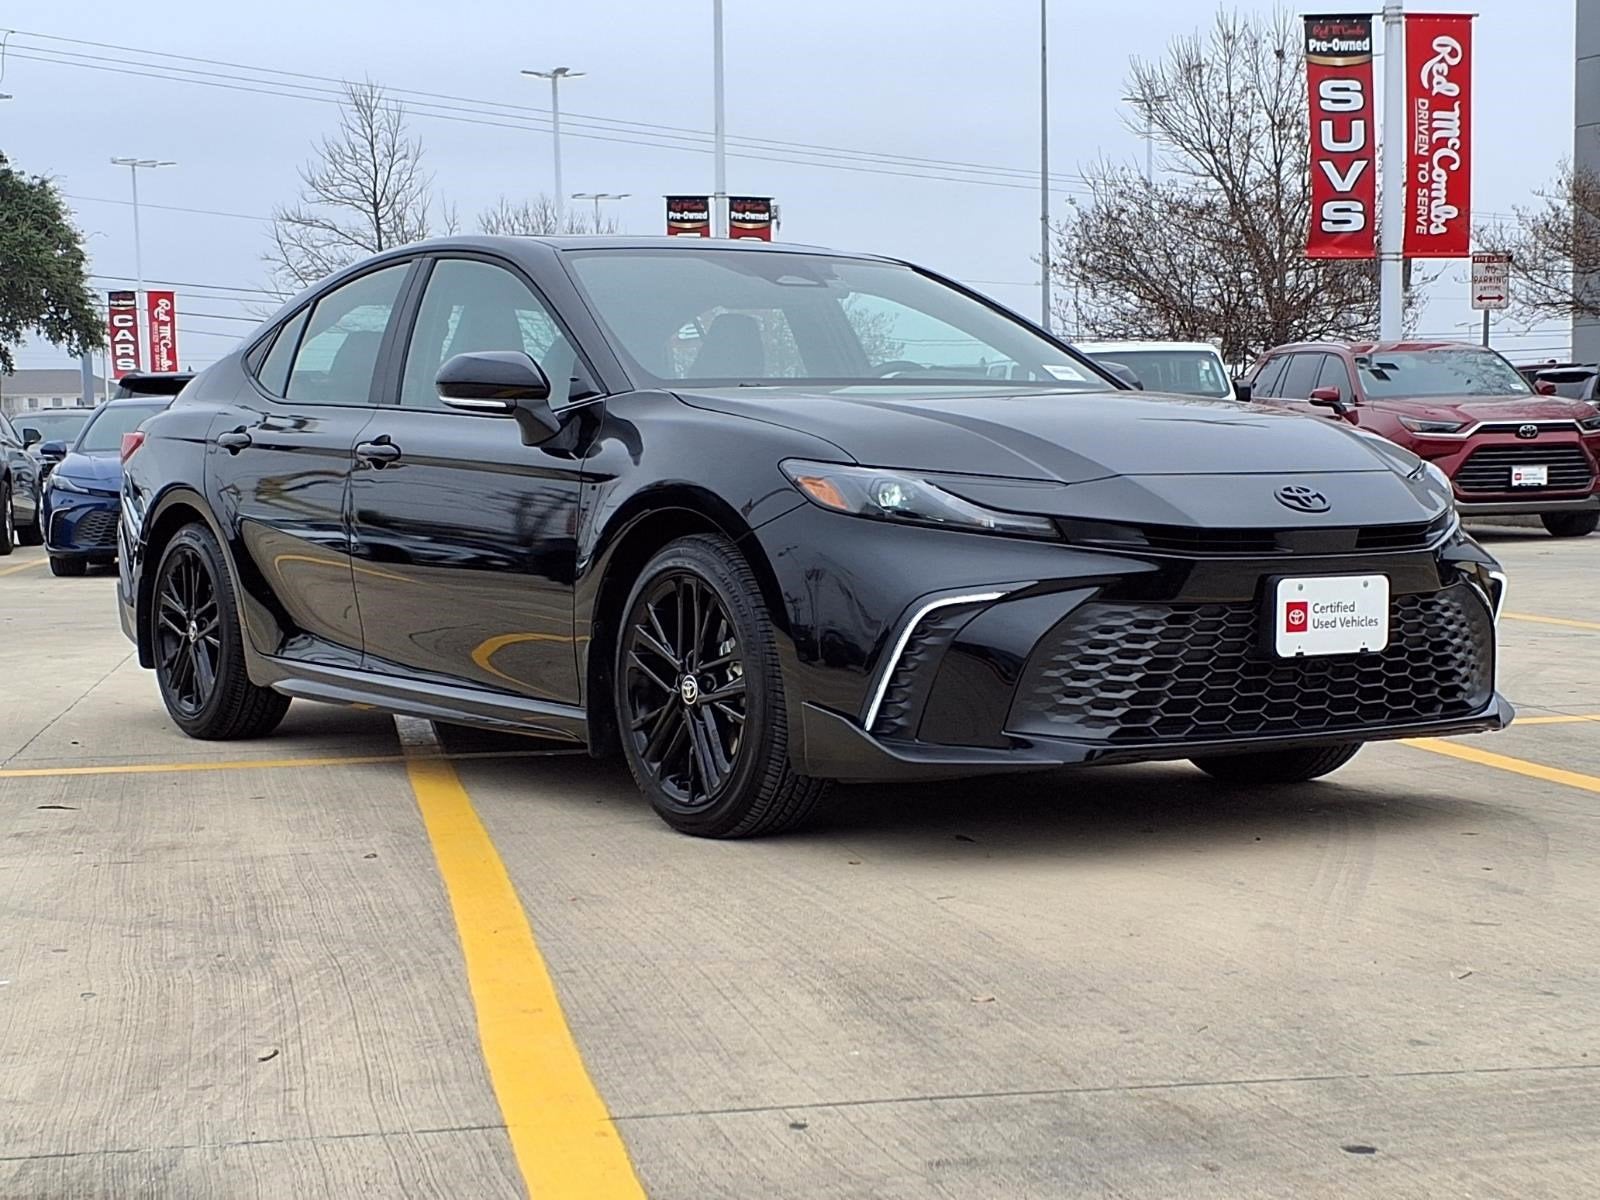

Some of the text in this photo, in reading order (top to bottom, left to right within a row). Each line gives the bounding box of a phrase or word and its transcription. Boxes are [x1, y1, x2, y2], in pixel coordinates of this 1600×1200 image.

[1308, 38, 1370, 52] Pre-Owned
[1420, 35, 1462, 97] Red
[1319, 79, 1368, 233] SUVS
[1416, 98, 1429, 235] DRIVEN TO SERVE
[668, 211, 708, 220] Pre-Owned
[1485, 266, 1496, 274] NO
[1473, 276, 1507, 284] PARKING
[153, 299, 171, 321] Red
[113, 315, 136, 371] CARS
[1312, 601, 1356, 614] Certified
[1312, 616, 1379, 629] Used Vehicles
